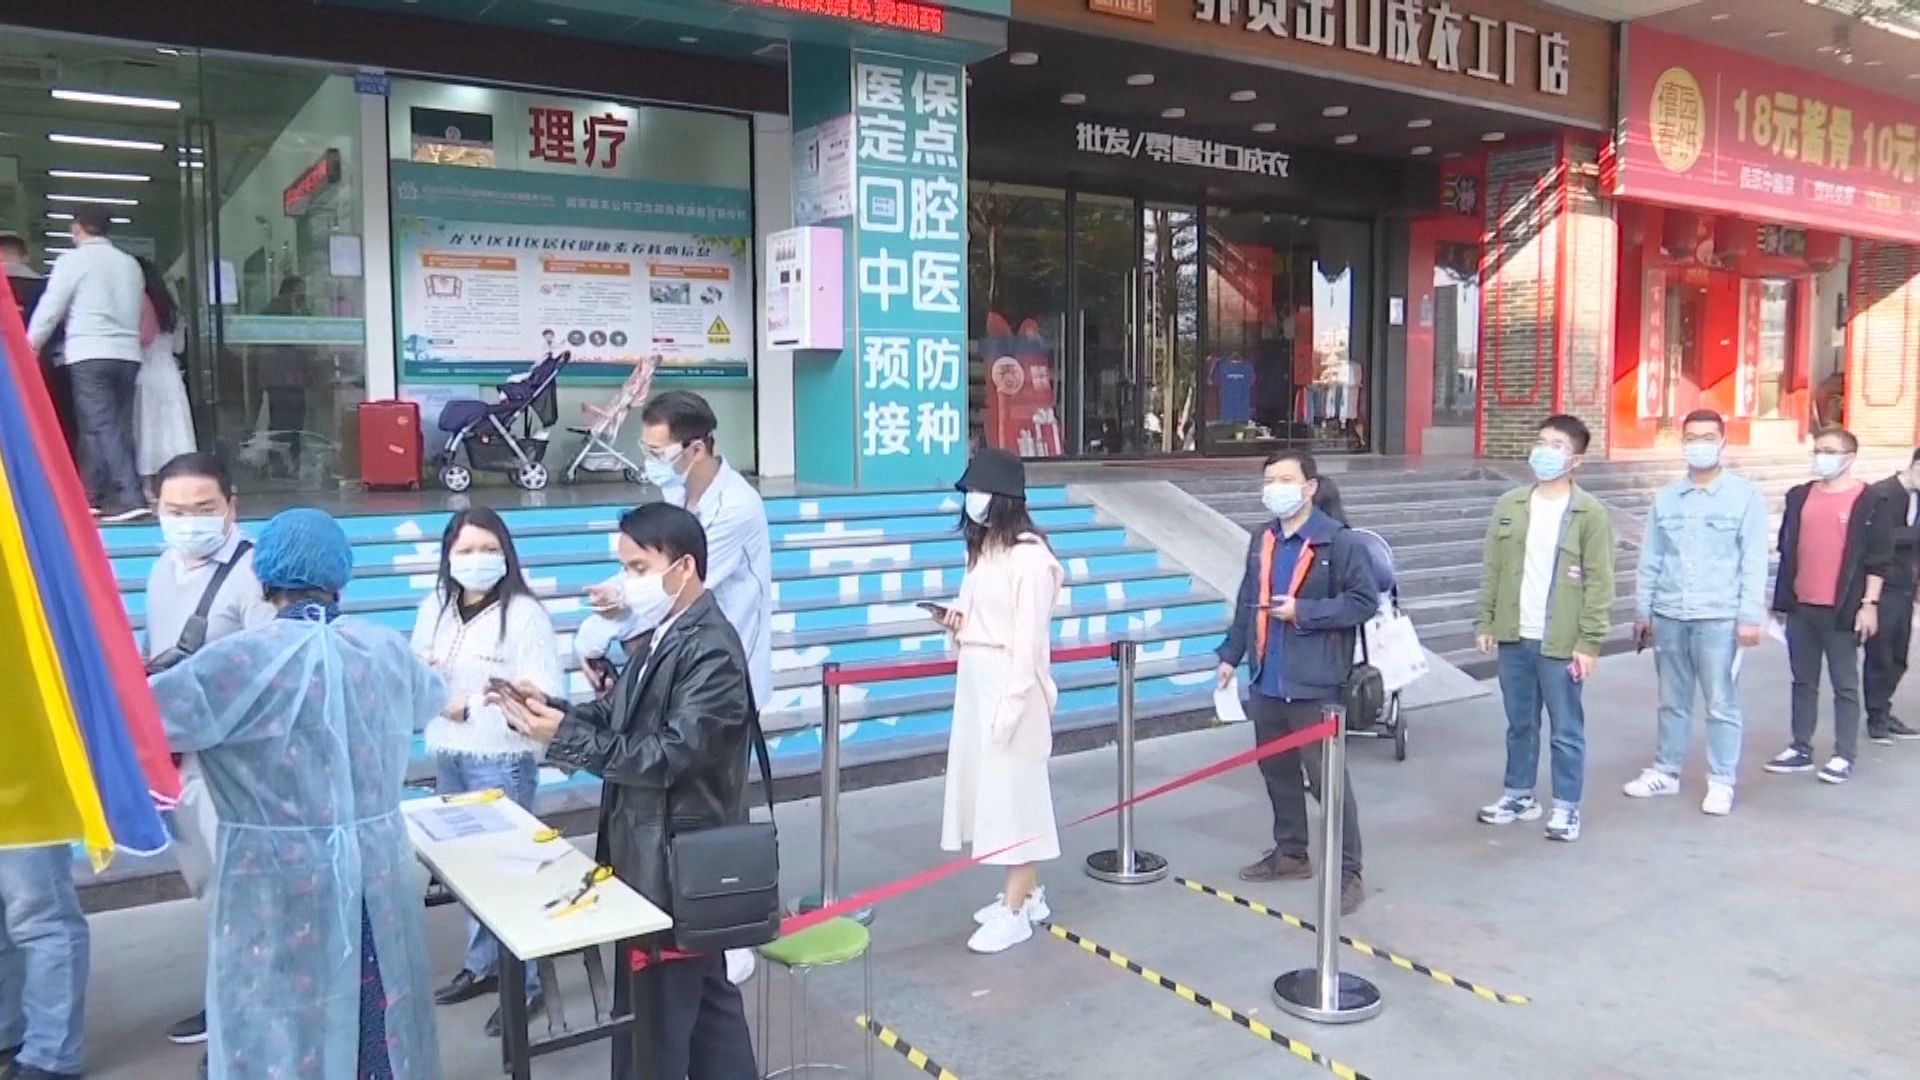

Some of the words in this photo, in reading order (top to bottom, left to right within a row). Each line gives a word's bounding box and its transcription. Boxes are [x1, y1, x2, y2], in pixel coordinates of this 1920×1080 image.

[857, 62, 959, 118] 医保
[528, 107, 628, 169] 理疗
[859, 113, 958, 168] 定点
[1076, 122, 1290, 177] 批发/零售出口成衣
[1734, 89, 1854, 172] 18元酱骨
[1863, 121, 1920, 184] 10元
[859, 175, 960, 241] 口腔
[859, 246, 961, 313] 中医
[863, 335, 960, 392] 预防
[863, 401, 960, 457] 接种
